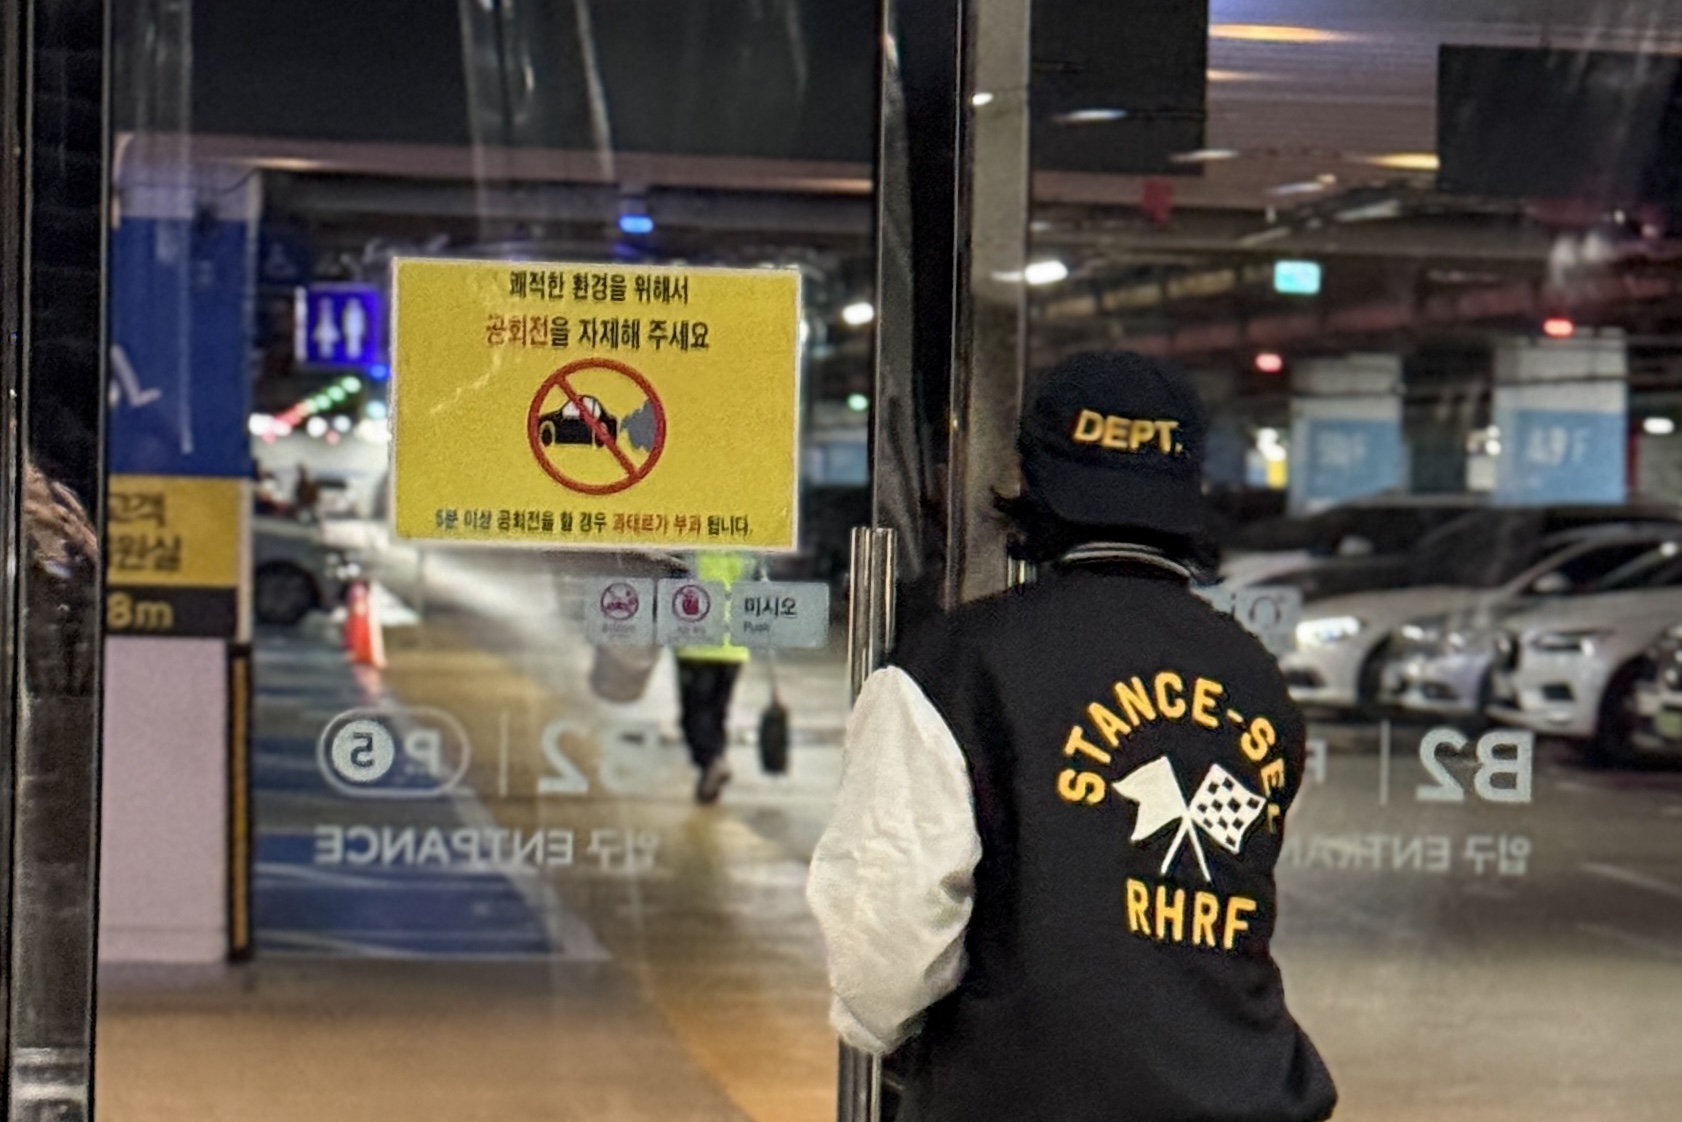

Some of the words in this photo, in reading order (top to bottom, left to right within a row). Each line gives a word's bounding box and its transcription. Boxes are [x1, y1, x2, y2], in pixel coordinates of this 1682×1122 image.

[509, 269, 566, 300] 쾌적한
[572, 272, 628, 303] 환경을
[634, 274, 689, 304] 위해서
[486, 313, 570, 348] 공회전을
[577, 317, 640, 350] 자제해
[648, 319, 710, 351] 주세요
[1072, 408, 1184, 456] DEPT.
[463, 509, 493, 531] 이상
[497, 509, 554, 532] 공회전을
[580, 511, 607, 534] 경우
[673, 513, 702, 536] 부과
[110, 533, 182, 572] 원실
[743, 596, 798, 620] 미시오
[1126, 877, 1257, 950] RHRF
